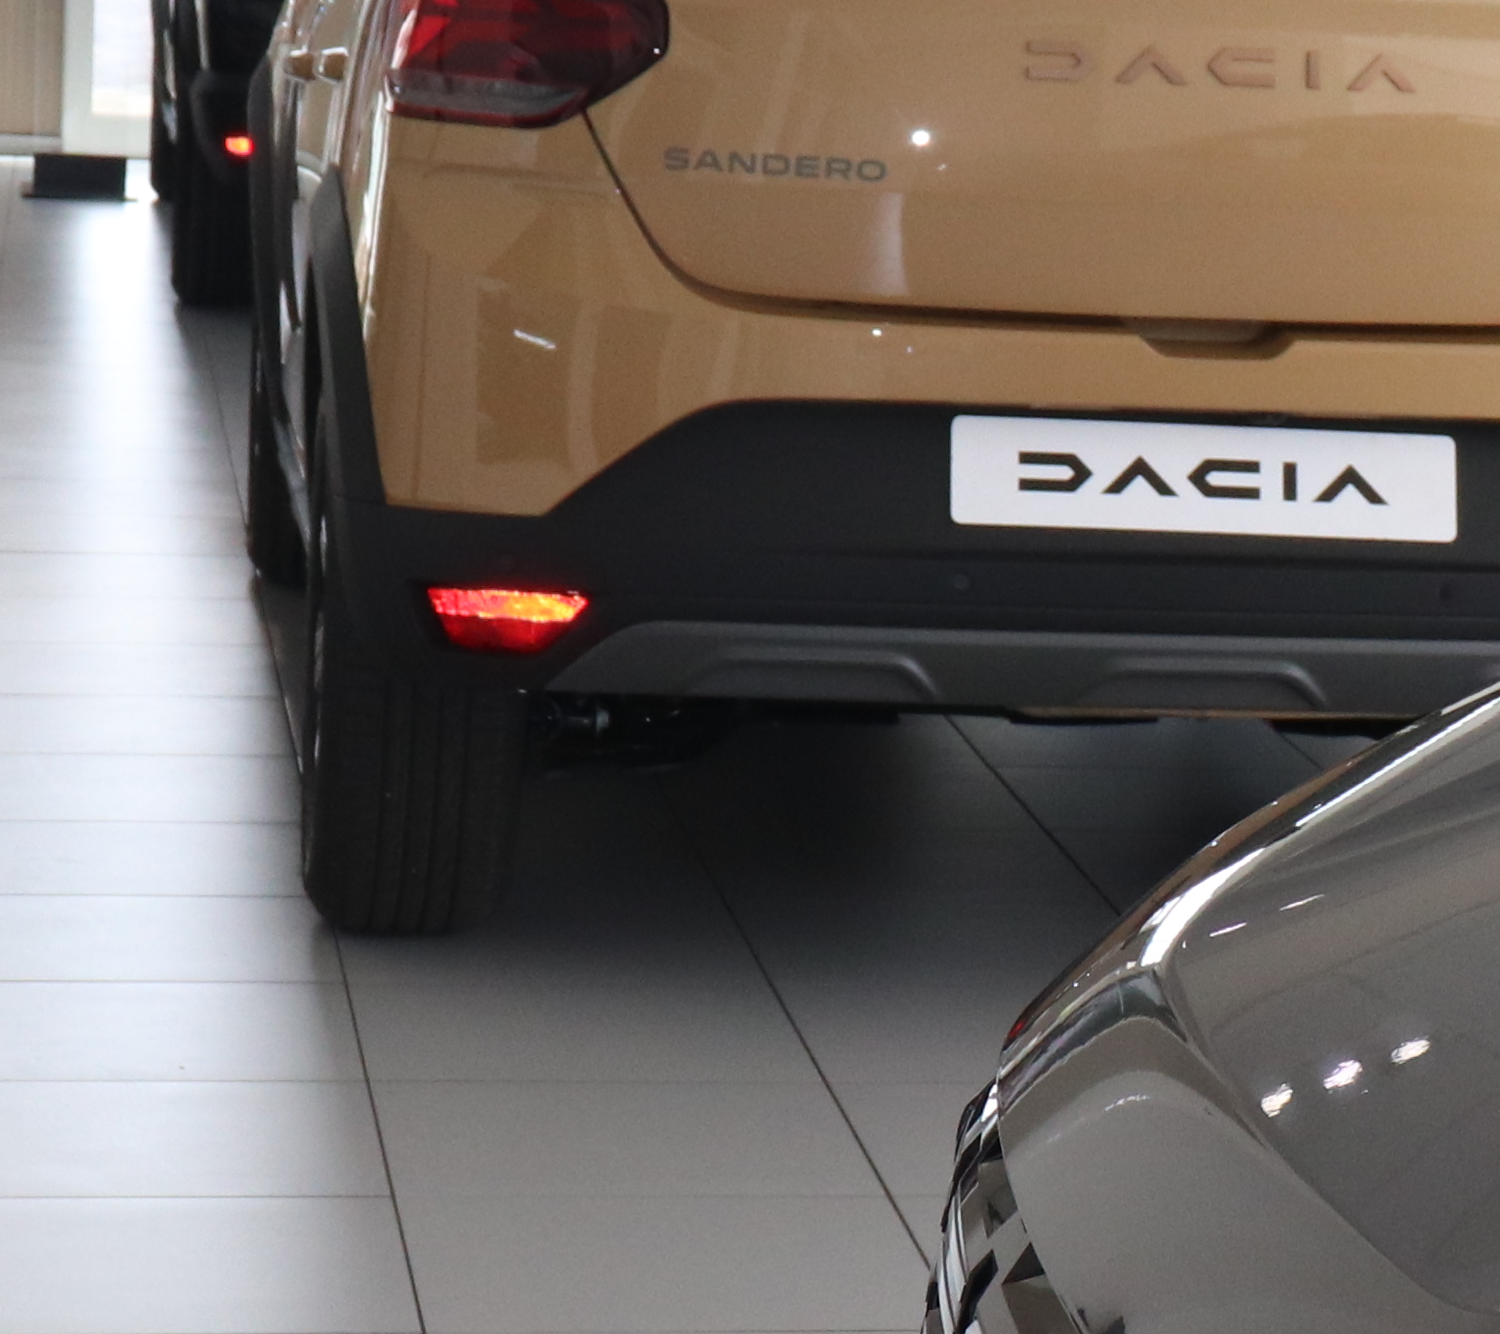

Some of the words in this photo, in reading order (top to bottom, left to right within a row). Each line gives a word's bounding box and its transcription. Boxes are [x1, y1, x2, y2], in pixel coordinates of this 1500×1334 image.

[1025, 41, 1416, 93] DACIA
[664, 146, 887, 183] SANDERO
[1017, 450, 1389, 506] DACIA
